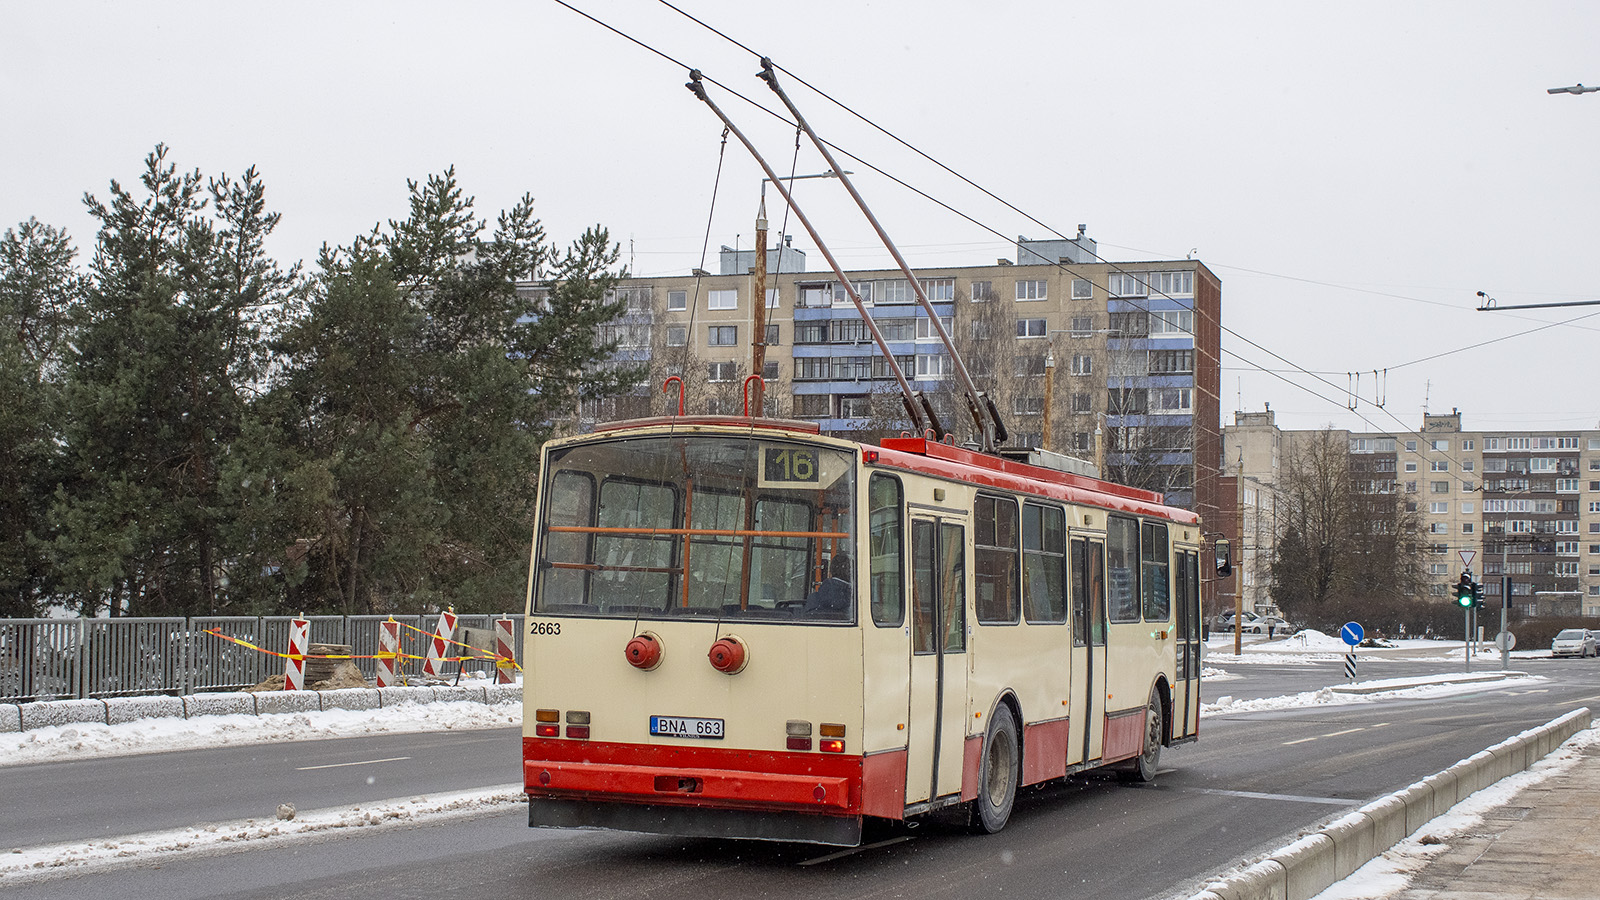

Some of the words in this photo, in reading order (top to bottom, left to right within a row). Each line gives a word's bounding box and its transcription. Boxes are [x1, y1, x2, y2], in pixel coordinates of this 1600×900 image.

[776, 449, 813, 479] 16
[530, 622, 561, 635] 2663
[660, 719, 687, 733] BNA
[697, 721, 720, 735] 663
